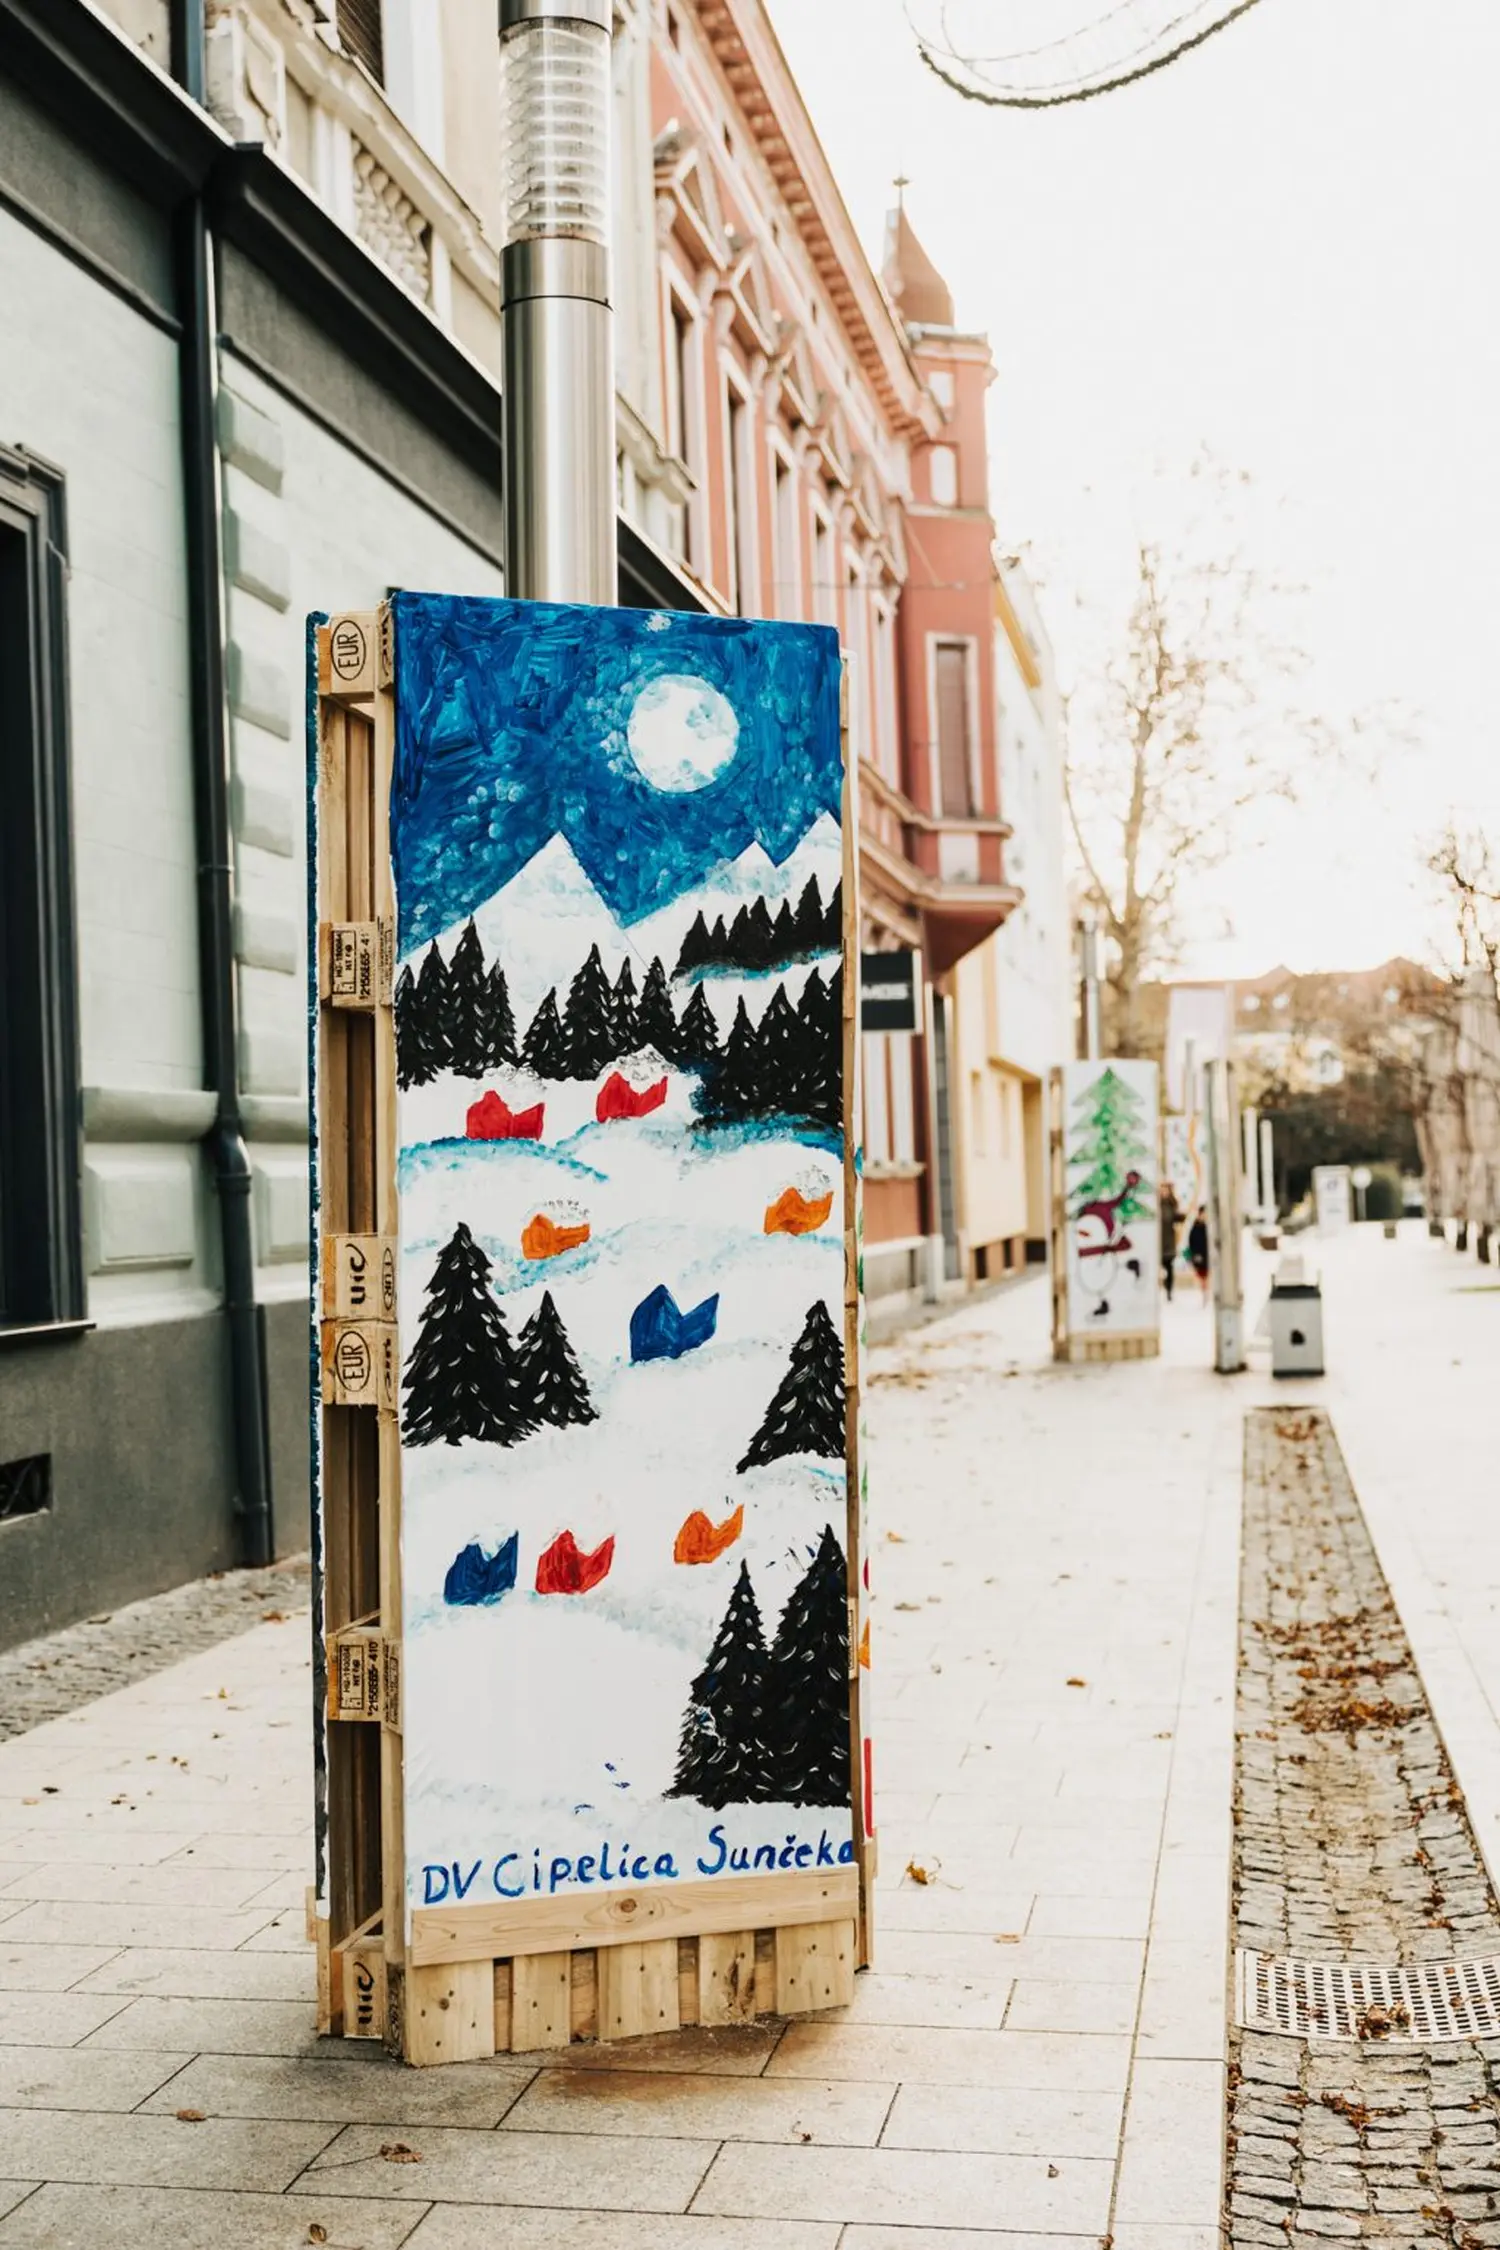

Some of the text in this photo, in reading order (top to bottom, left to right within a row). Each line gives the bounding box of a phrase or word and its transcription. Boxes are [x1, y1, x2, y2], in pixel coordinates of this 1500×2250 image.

[336, 633, 360, 669] EUR
[341, 1344, 365, 1381] EUR
[422, 1860, 482, 1904] DV
[493, 1842, 679, 1897] Cipelica
